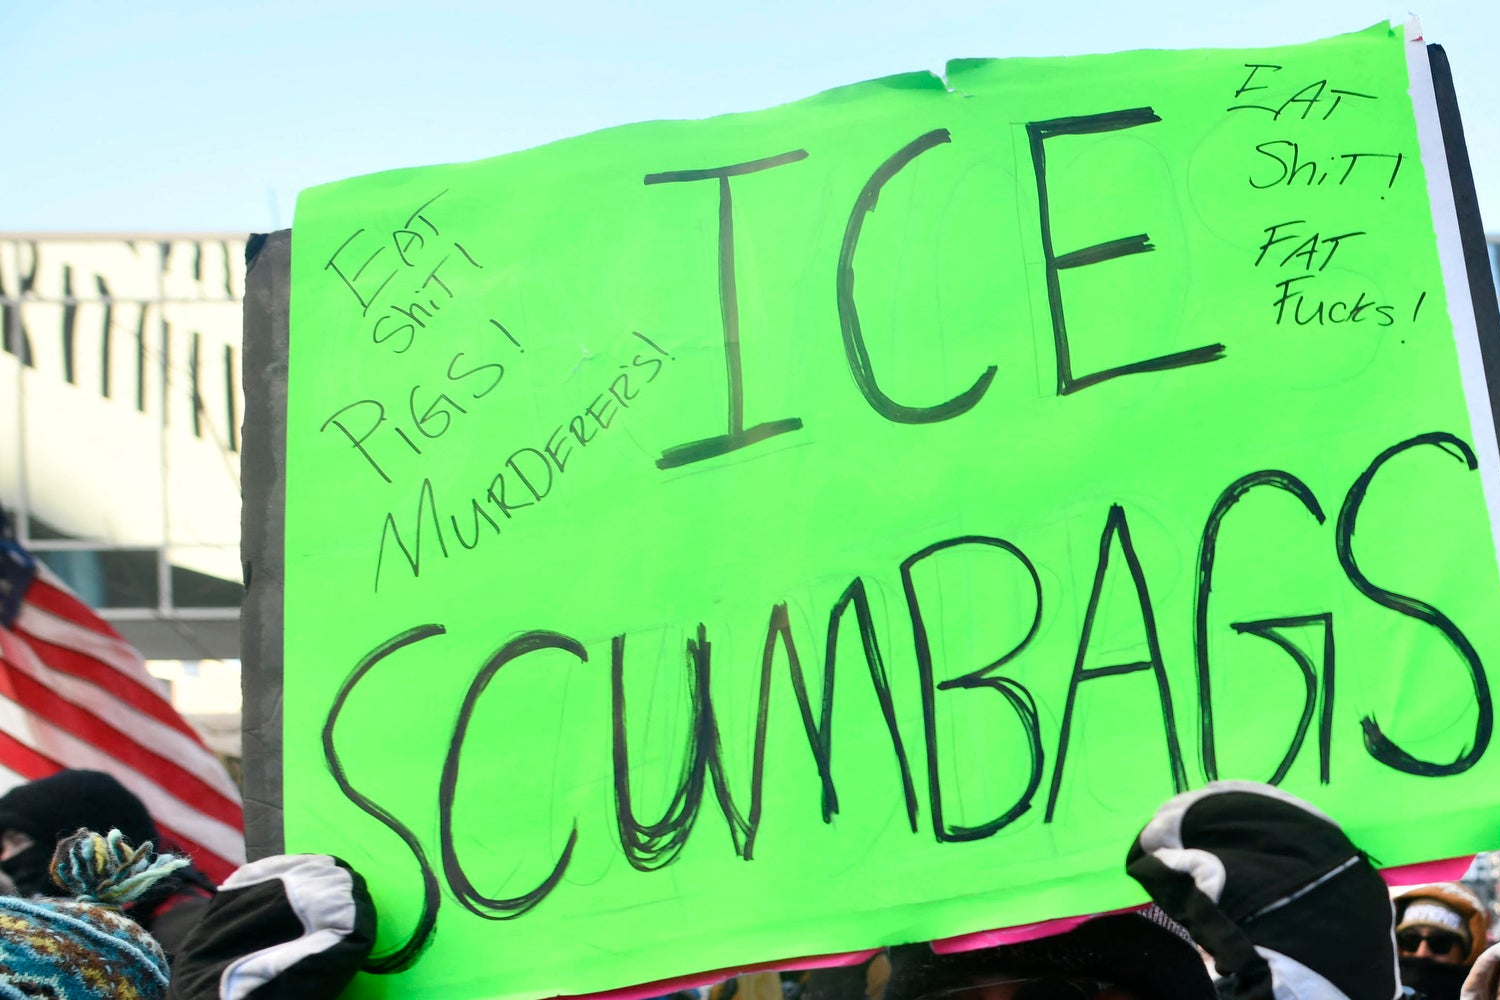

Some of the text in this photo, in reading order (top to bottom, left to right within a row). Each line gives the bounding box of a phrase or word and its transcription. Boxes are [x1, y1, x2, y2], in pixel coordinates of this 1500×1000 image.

[1227, 63, 1378, 121] EAT
[325, 188, 449, 317] EAT
[643, 106, 1227, 470] ICE
[1254, 219, 1367, 272] FAT
[322, 430, 1493, 975] SCUMBAGS
